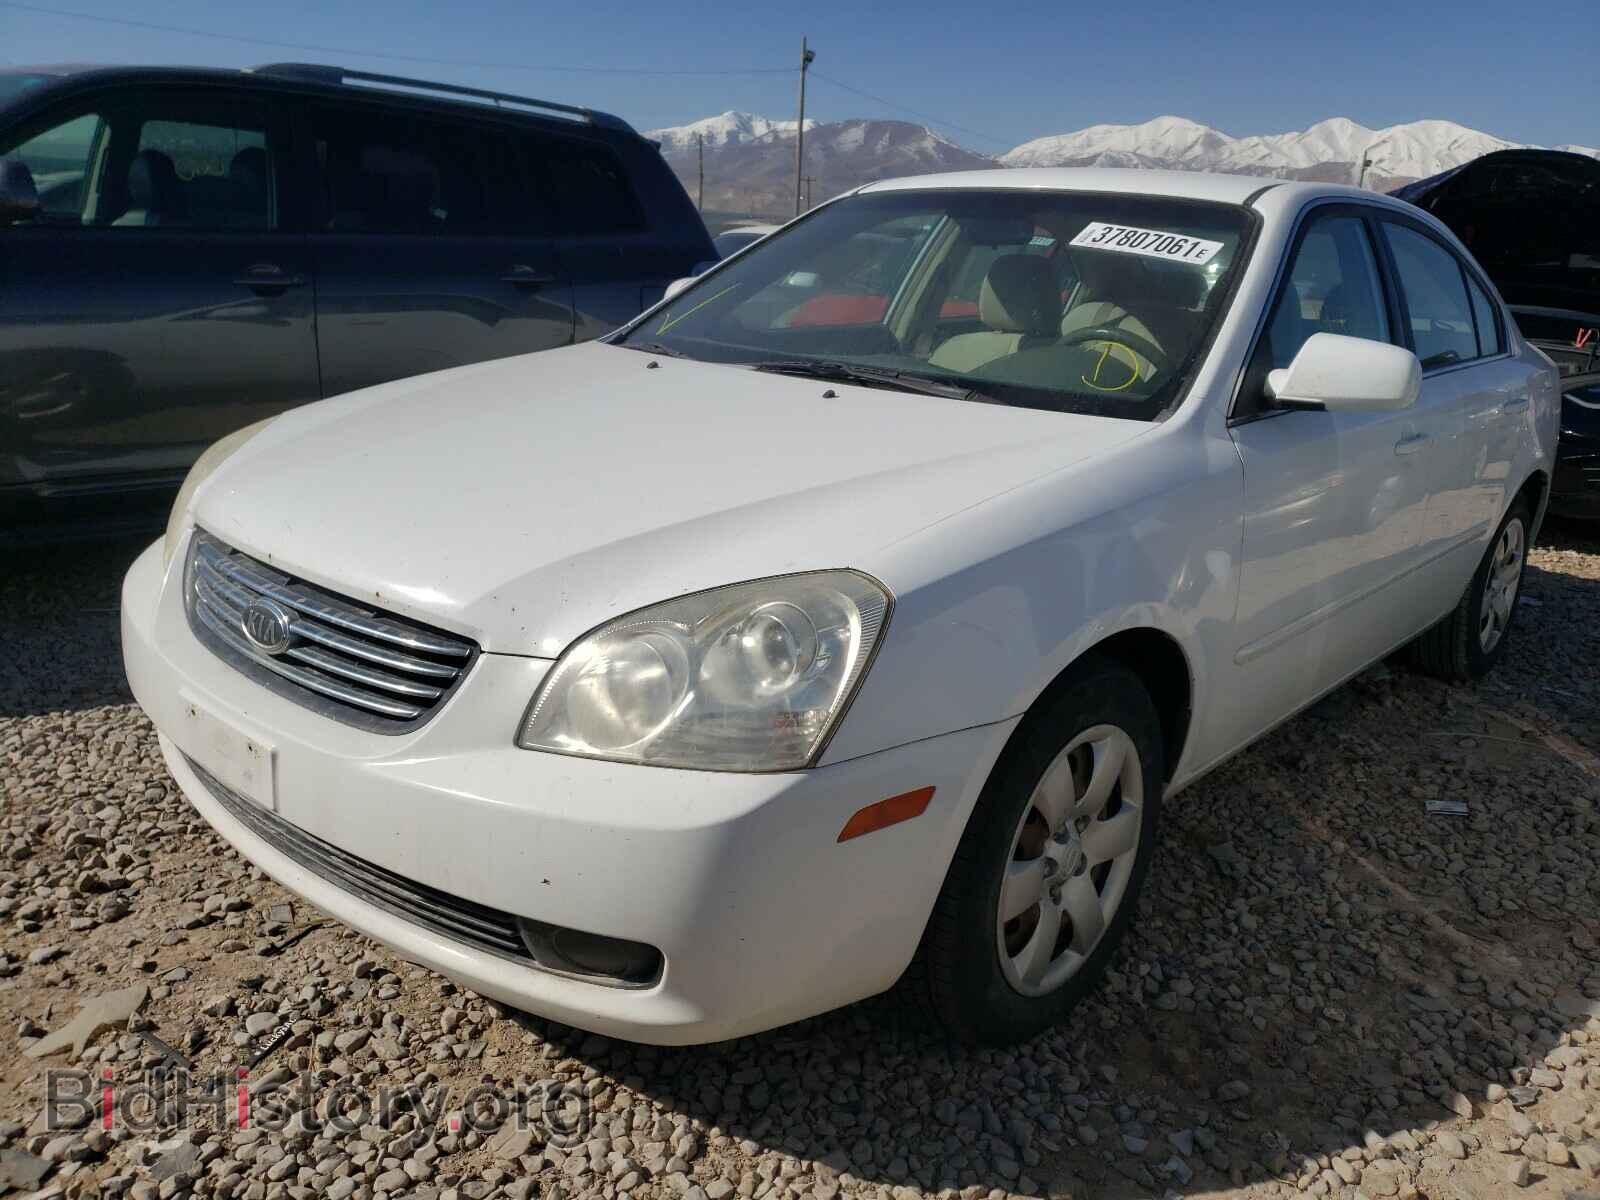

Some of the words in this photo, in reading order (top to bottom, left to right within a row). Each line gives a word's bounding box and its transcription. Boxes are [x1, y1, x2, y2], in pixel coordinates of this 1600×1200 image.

[1092, 226, 1201, 258] 37807061
[1196, 249, 1209, 259] E
[247, 609, 275, 643] KIA
